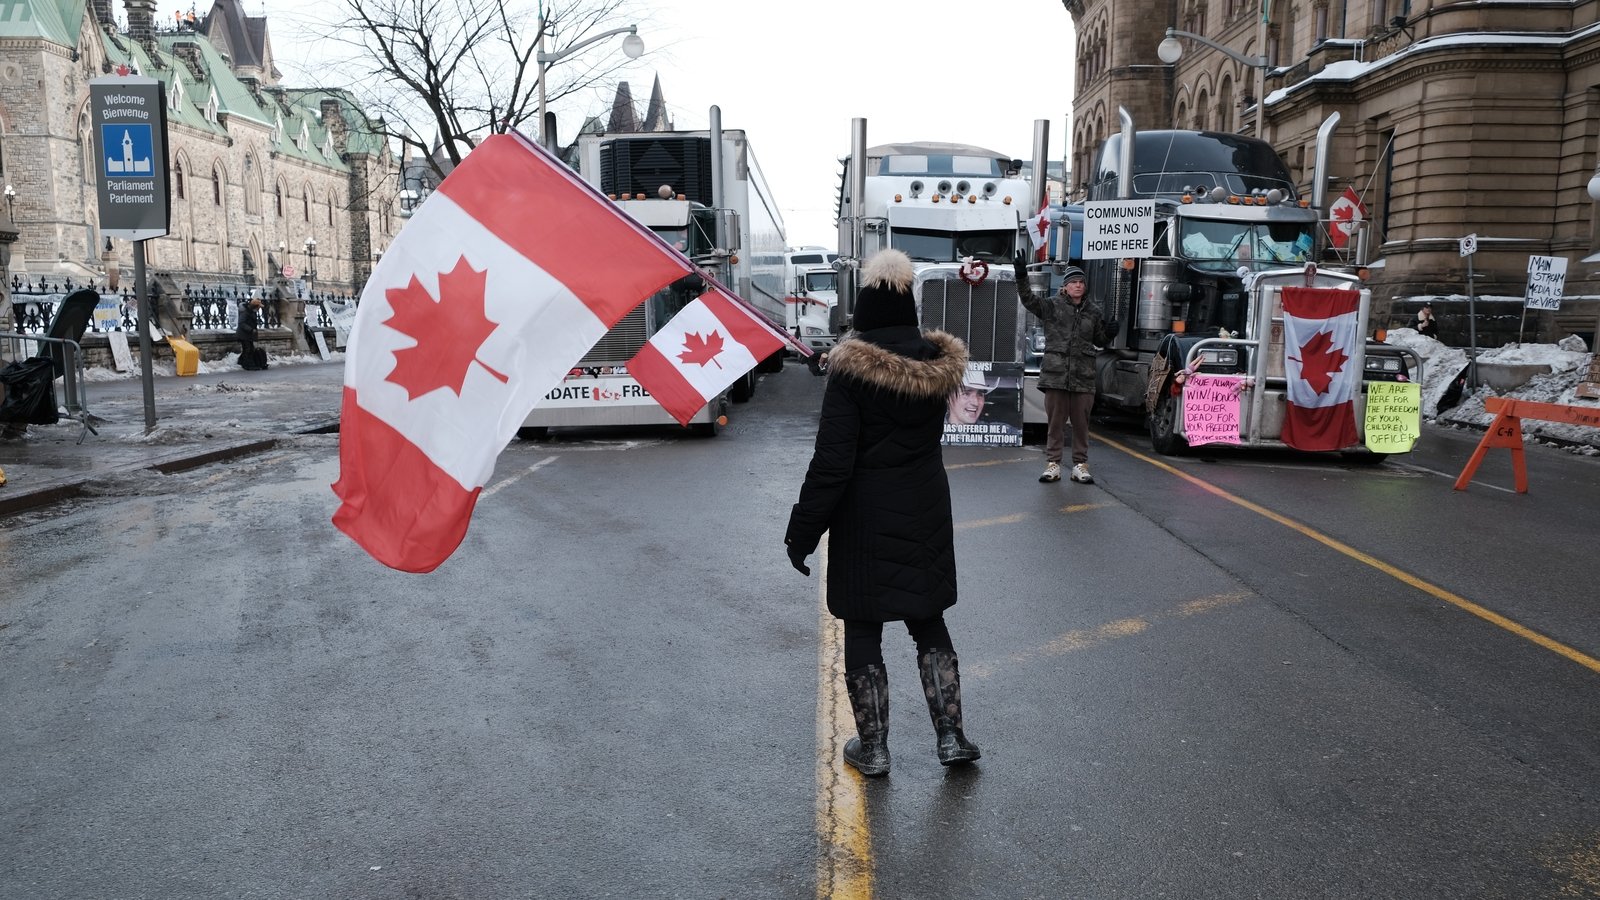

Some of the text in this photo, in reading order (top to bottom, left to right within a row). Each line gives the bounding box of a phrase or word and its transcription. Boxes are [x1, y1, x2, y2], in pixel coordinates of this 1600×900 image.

[104, 94, 145, 105] Welcome
[102, 108, 149, 120] Bienvenue
[108, 180, 154, 190] Parliament
[110, 193, 154, 204] Parlement
[1087, 206, 1152, 218] COMMUNISM
[1100, 223, 1138, 234] HAS NO
[1088, 239, 1148, 251] HOME HERE
[1530, 256, 1552, 271] MAIN
[1533, 272, 1565, 285] STREAM
[1529, 283, 1550, 296] MEDIA
[1528, 296, 1560, 308] THE VIRUS
[968, 362, 992, 372] NEWS!
[1190, 376, 1236, 389] TRUE ALWAY
[1186, 388, 1211, 400] WIN!
[1370, 384, 1408, 394] WE ARE
[1186, 403, 1226, 412] SOLDIER
[1384, 406, 1418, 414] FREEDOM
[1188, 413, 1236, 422] DEAD FOR
[1380, 415, 1402, 424] YOUR
[958, 424, 988, 434] OFFERED
[990, 425, 1000, 434] ME
[1002, 425, 1006, 434] A
[1186, 422, 1238, 432] YOUR FREEDOM
[1366, 424, 1408, 432] CHILDREN
[946, 434, 962, 442] THE
[962, 434, 982, 442] TRAIN
[984, 435, 1017, 444] STATION!
[1370, 434, 1414, 444] OFFICER
